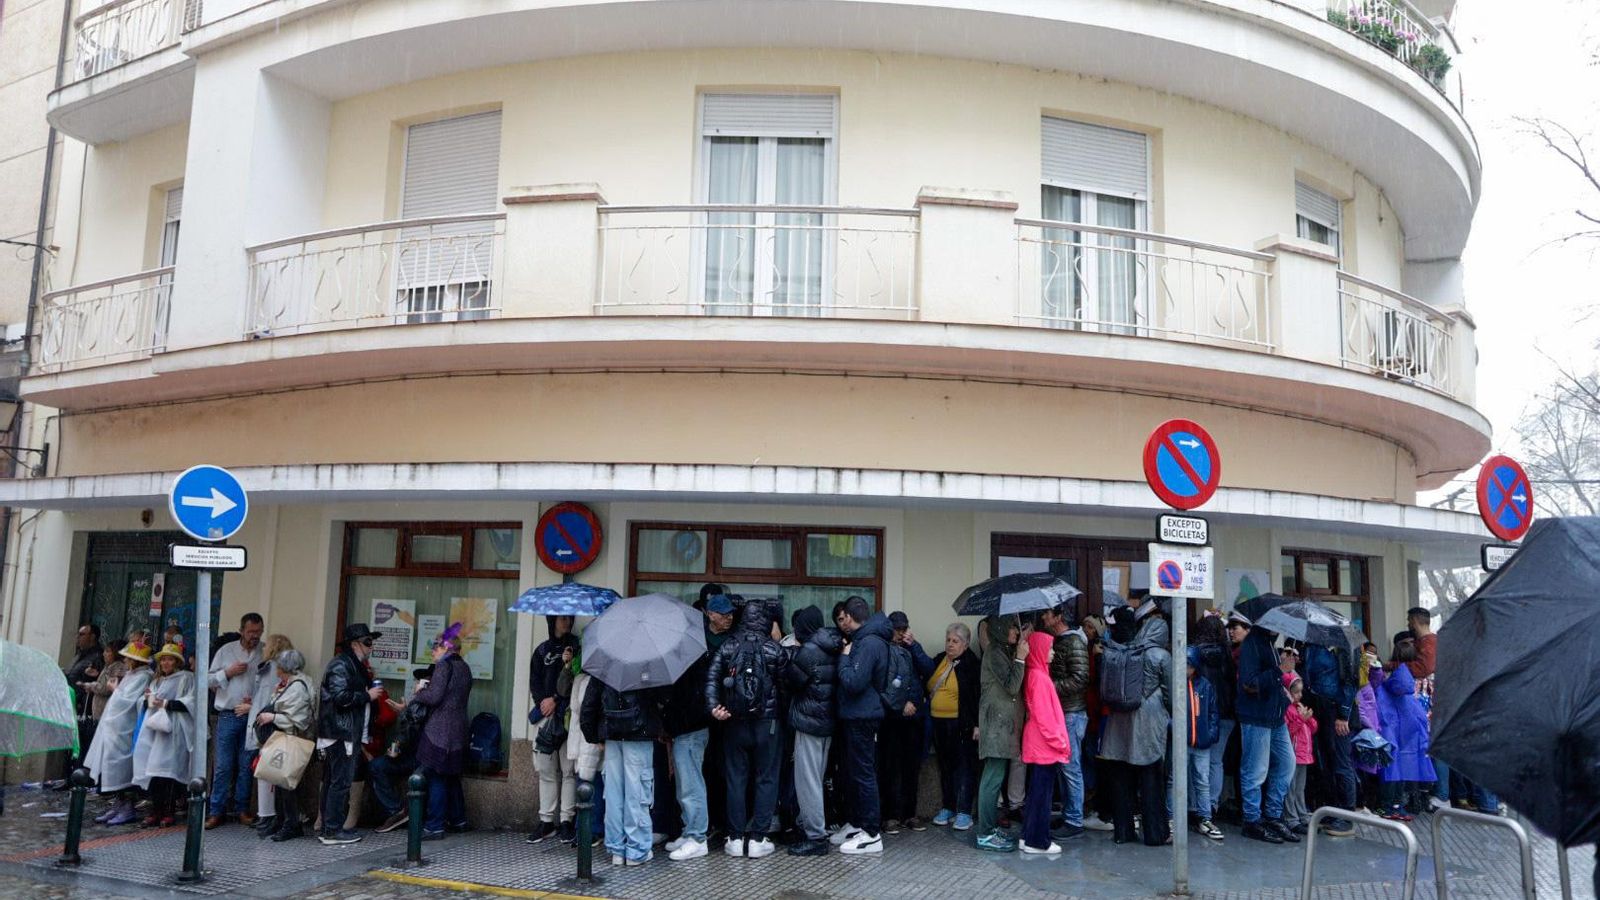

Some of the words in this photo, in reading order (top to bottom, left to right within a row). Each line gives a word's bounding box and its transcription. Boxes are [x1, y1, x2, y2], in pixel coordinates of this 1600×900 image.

[1167, 518, 1201, 530] EXCEPTO
[1163, 528, 1206, 540] BICICLETAS
[1184, 562, 1192, 571] 02
[1193, 565, 1197, 573] y
[1198, 563, 1207, 572] 03
[1190, 576, 1204, 584] MES
